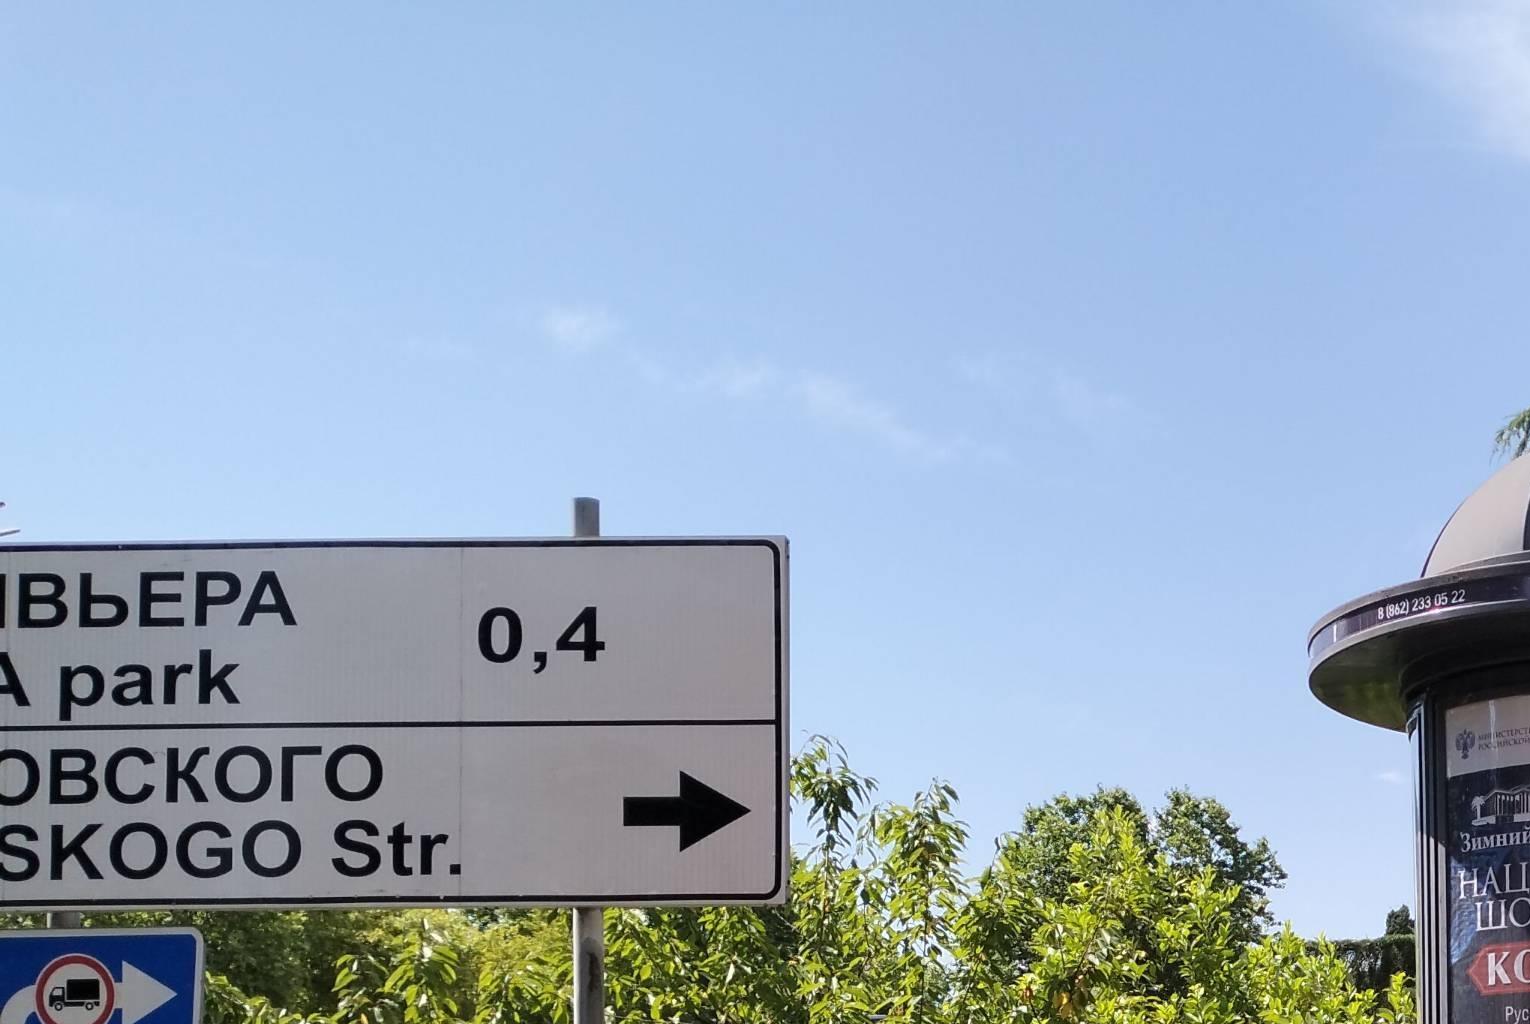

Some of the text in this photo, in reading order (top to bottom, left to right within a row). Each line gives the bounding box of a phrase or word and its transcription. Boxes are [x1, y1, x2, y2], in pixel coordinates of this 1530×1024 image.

[1377, 589, 1466, 620] 8 (862) 233 05 22
[478, 605, 606, 673] 0,4
[59, 648, 241, 722] park
[0, 818, 463, 882] SKOGO Str.
